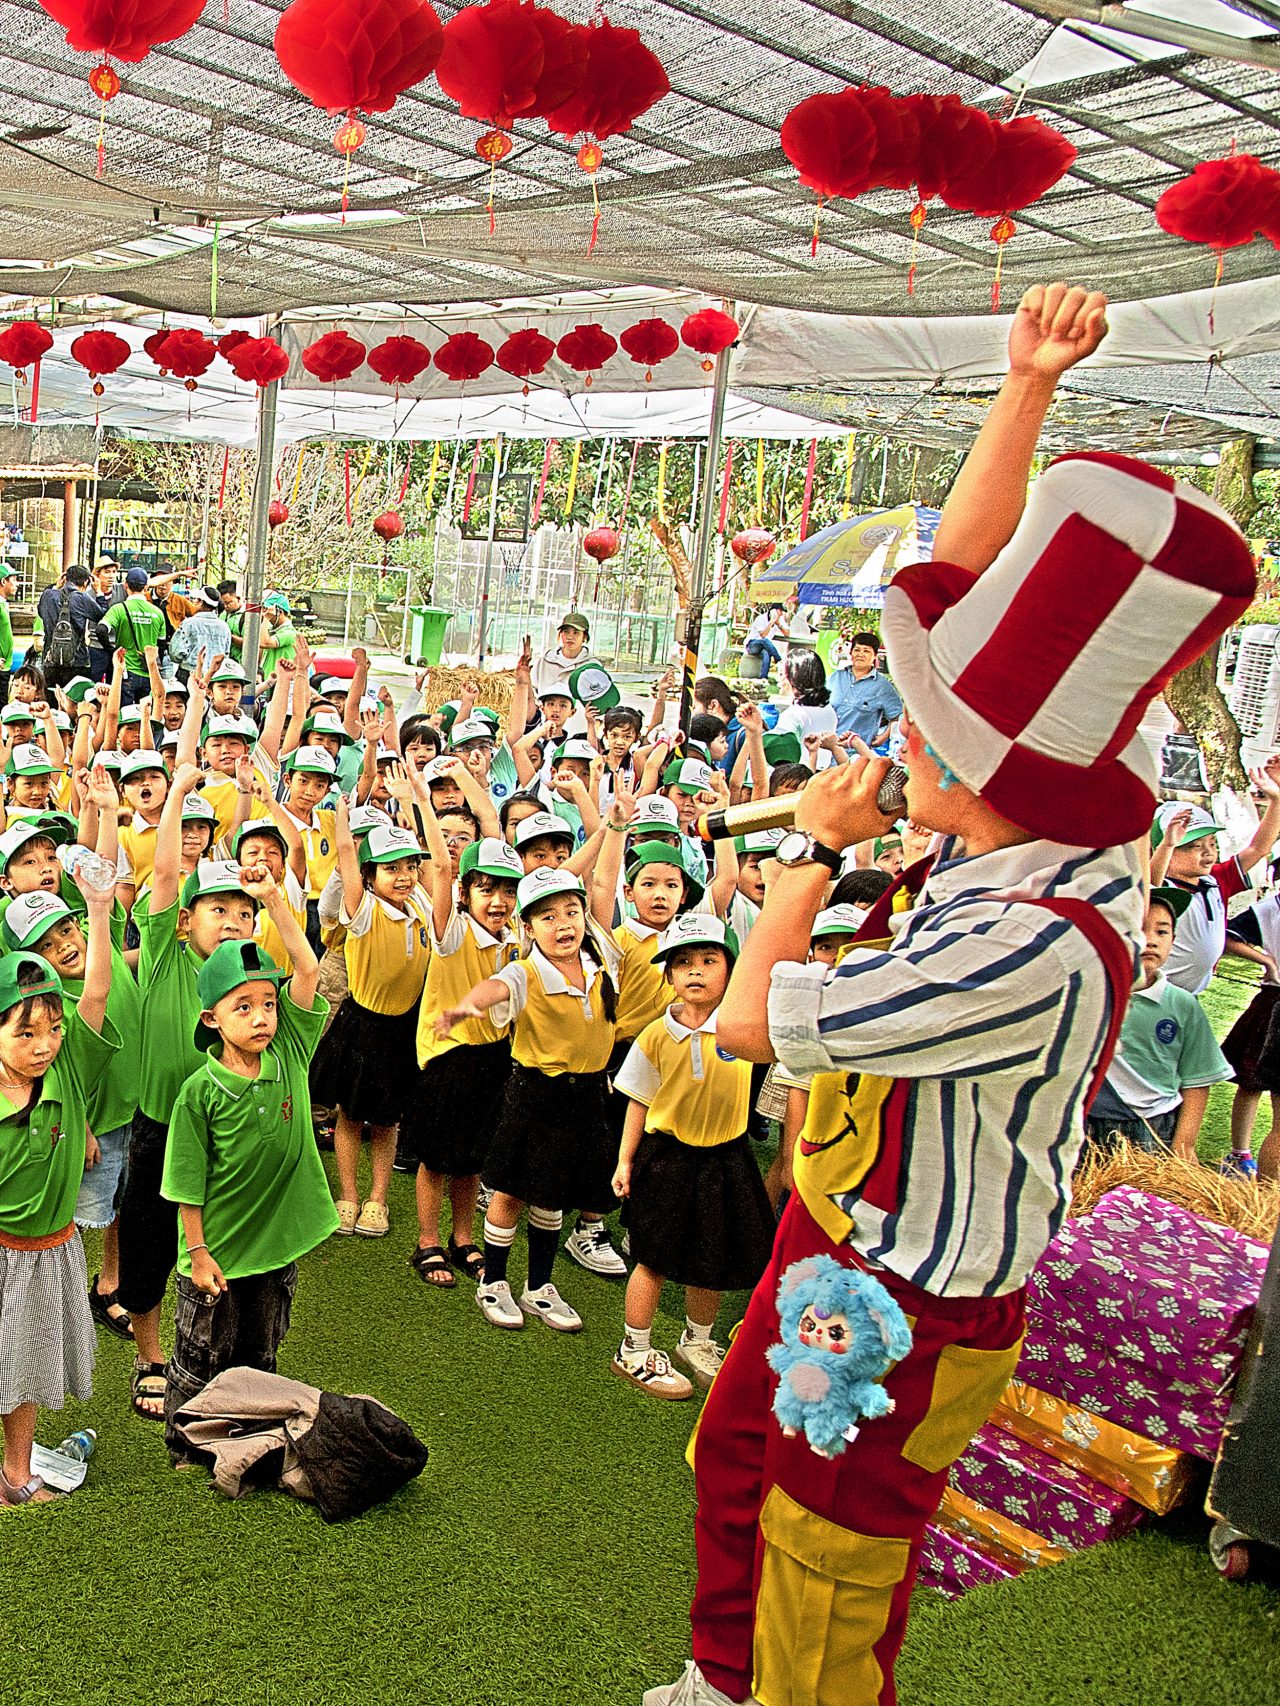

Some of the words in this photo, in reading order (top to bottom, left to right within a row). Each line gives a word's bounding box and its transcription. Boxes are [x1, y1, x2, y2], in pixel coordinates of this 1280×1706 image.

[341, 126, 359, 147] 福
[484, 134, 504, 155] 福
[995, 221, 1011, 239] 福
